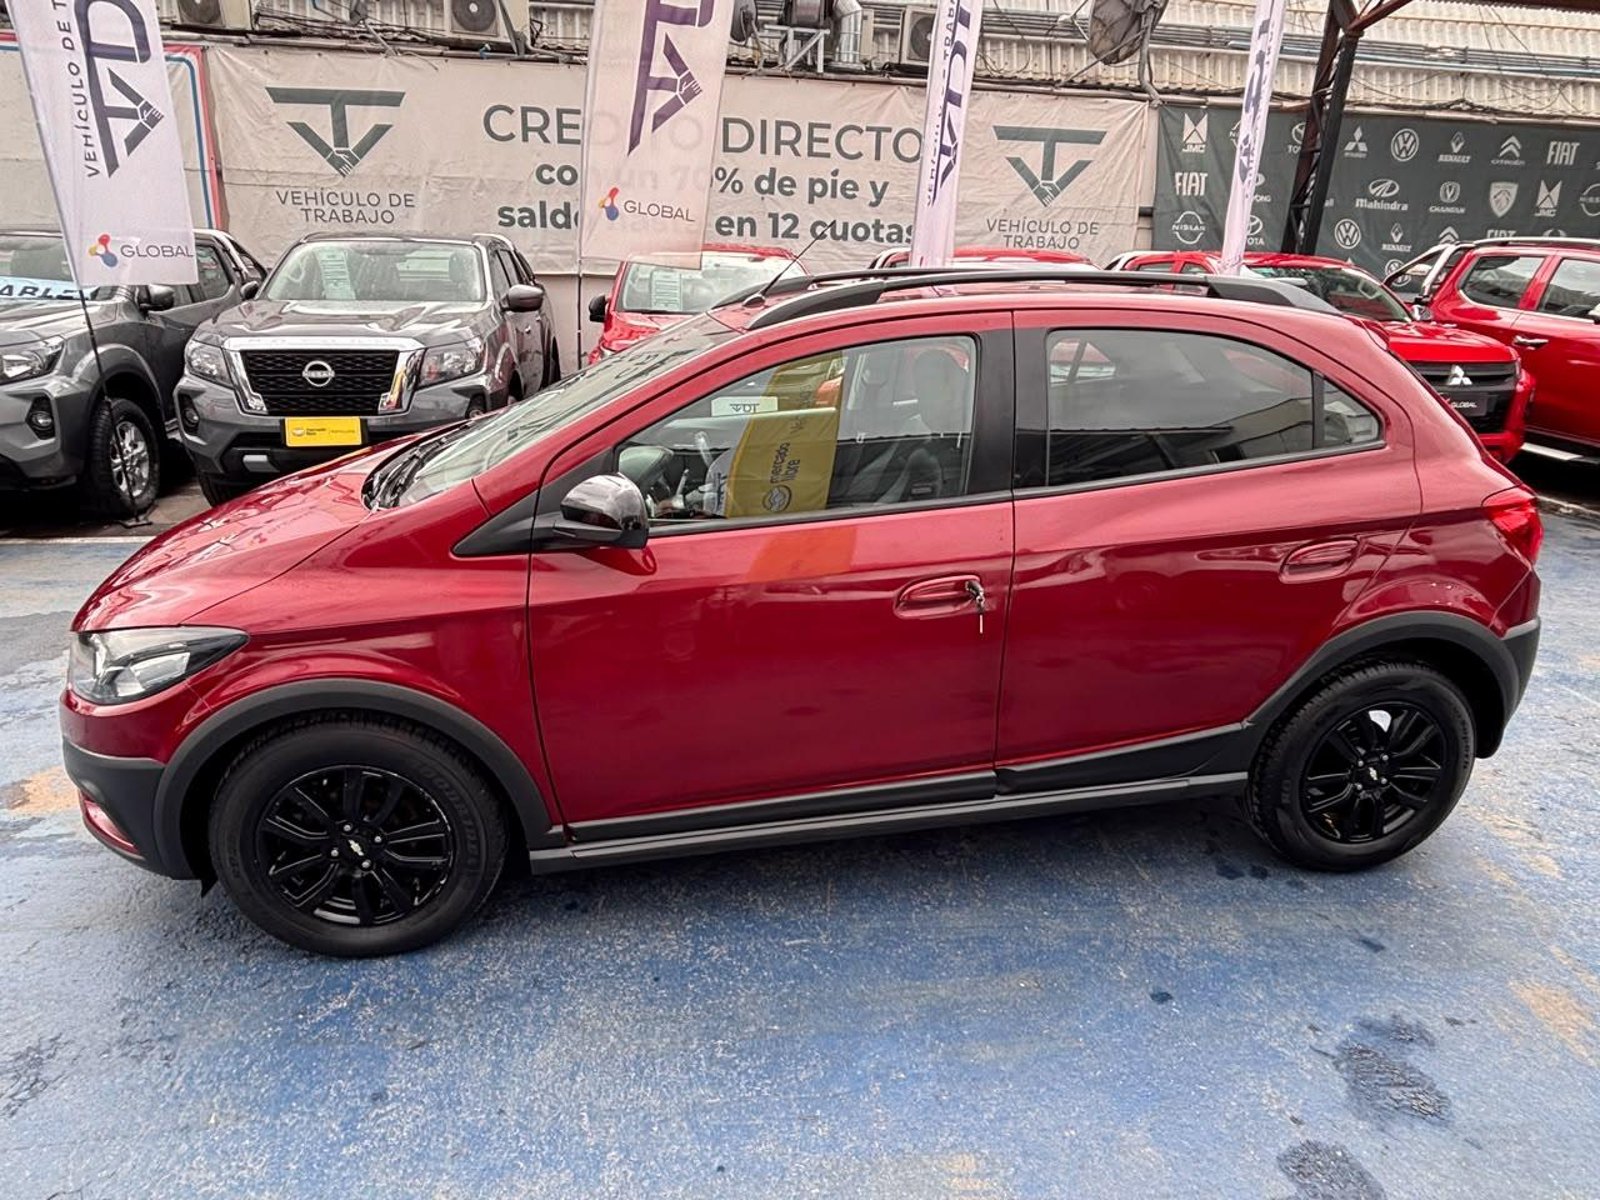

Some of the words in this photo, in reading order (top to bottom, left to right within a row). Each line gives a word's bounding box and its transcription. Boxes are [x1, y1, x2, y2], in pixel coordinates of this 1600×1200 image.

[57, 20, 76, 51] DE
[68, 62, 101, 177] VEHÍCULO
[722, 117, 922, 163] DIRECTO
[1182, 145, 1206, 153] JMC
[1546, 141, 1580, 165] FIAT
[754, 167, 797, 196] de
[868, 181, 889, 207] y
[1175, 172, 1208, 197] FIAT
[276, 187, 382, 208] VEHÍCULO
[388, 193, 416, 208] DE
[1355, 198, 1409, 211] Mahindra
[300, 208, 396, 225] TRABAJO
[624, 200, 696, 223] GLOBAL
[715, 214, 757, 237] en
[767, 212, 799, 239] 12
[809, 219, 913, 244] cuotas
[986, 215, 1072, 235] VEHÍCULO
[1077, 221, 1099, 236] DE
[1172, 224, 1206, 232] NISSAN
[120, 244, 194, 259] GLOBAL
[1003, 234, 1080, 250] TRABAJO
[302, 370, 335, 378] NISSAN
[1450, 401, 1478, 409] GLOBAL
